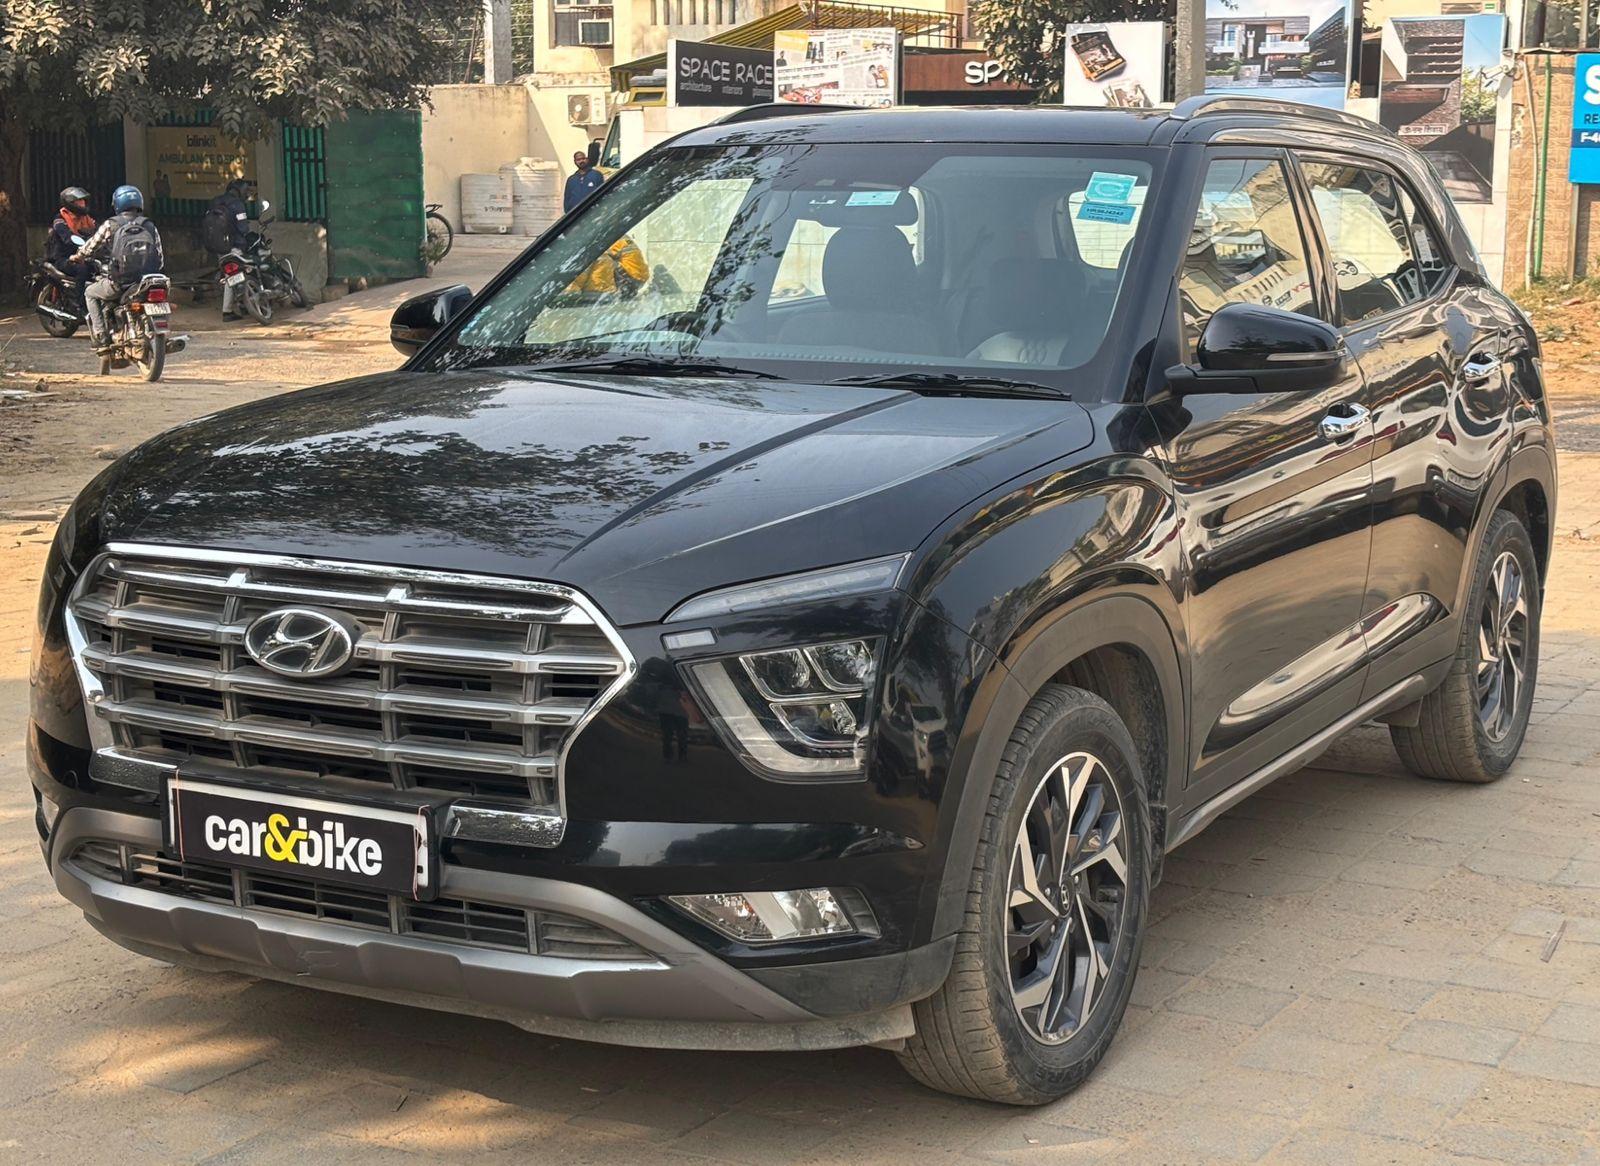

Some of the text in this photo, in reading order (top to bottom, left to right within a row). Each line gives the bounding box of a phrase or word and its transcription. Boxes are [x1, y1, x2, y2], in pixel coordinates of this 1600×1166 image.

[680, 57, 731, 81] SPACE
[735, 62, 774, 85] RACE
[680, 81, 712, 93] architecture
[722, 85, 743, 95] interiors
[1584, 114, 1600, 124] RE
[186, 134, 216, 148] blinkit
[1580, 132, 1600, 143] F-4
[204, 812, 383, 877] car&bike
